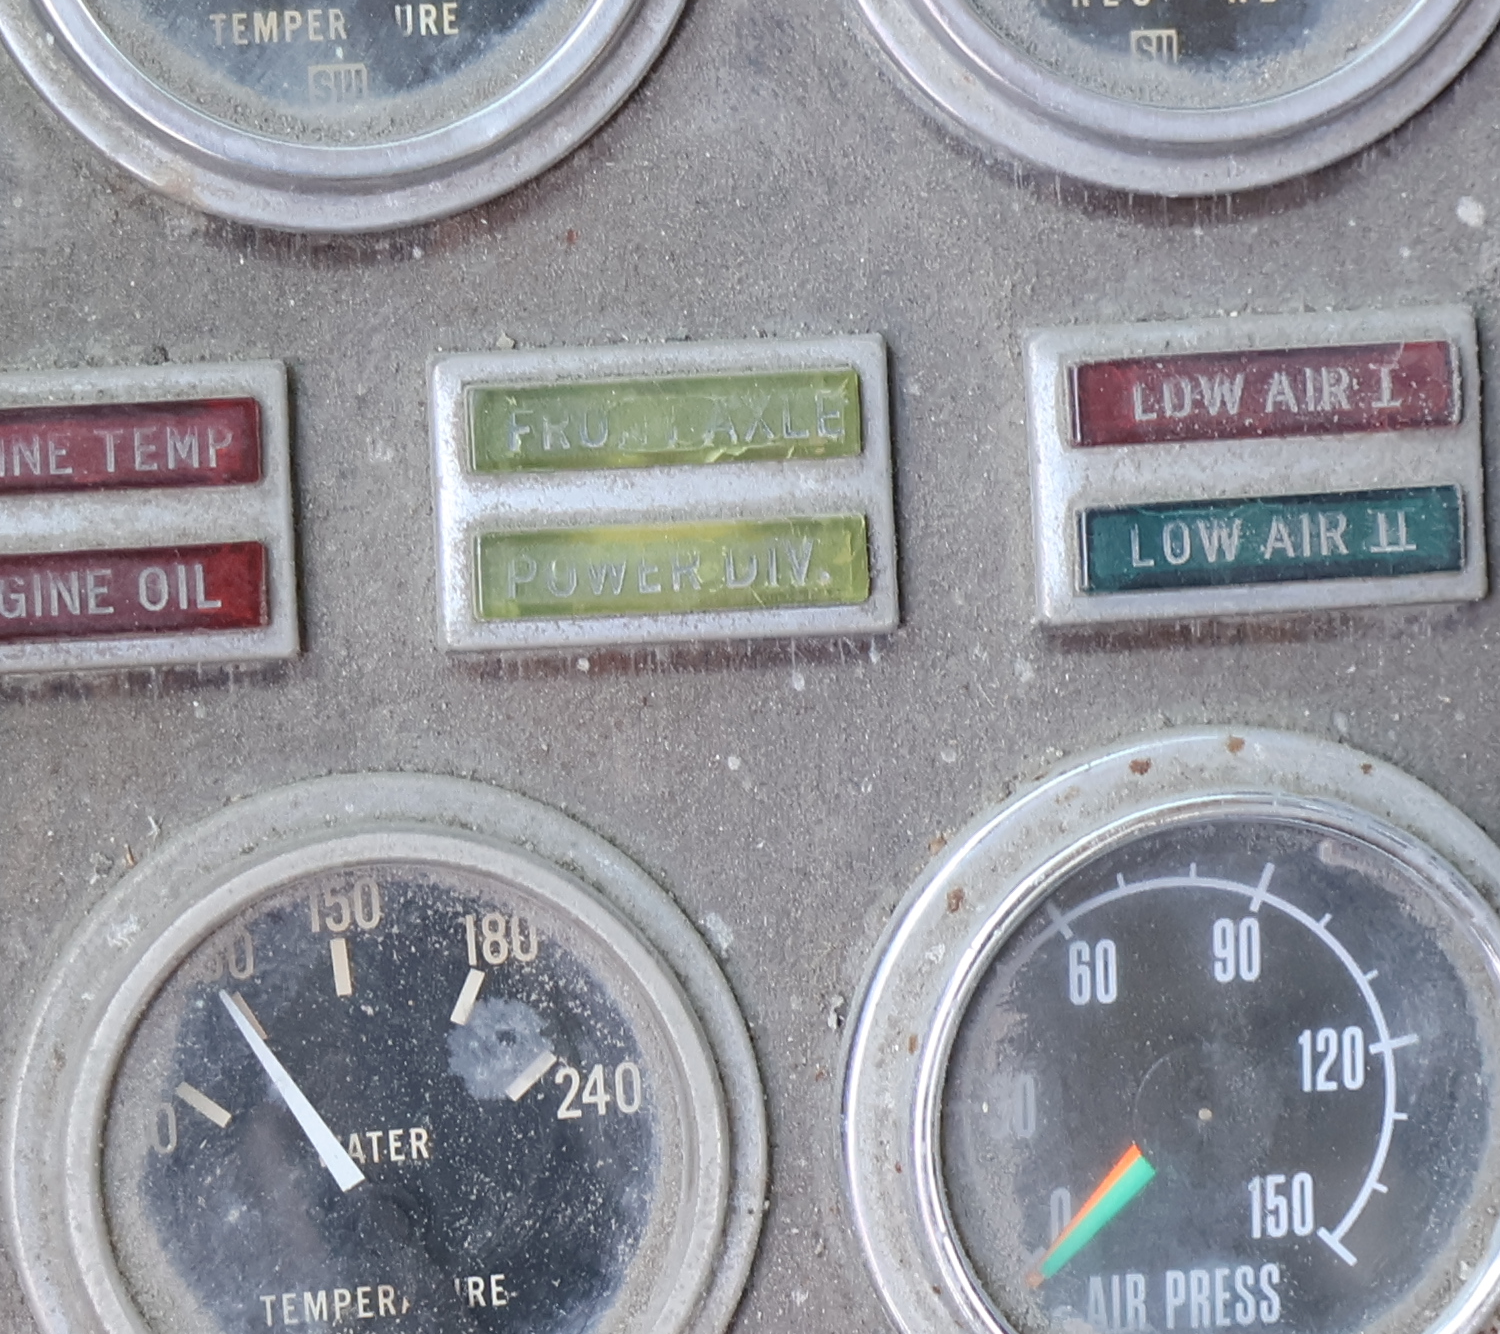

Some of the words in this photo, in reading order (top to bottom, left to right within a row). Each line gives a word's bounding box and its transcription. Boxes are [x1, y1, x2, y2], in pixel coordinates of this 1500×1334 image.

[208, 0, 460, 46] TEMPERURE
[702, 389, 846, 448] AXLE
[1132, 372, 1245, 421] LOW
[1264, 365, 1352, 414] AIR
[94, 424, 233, 474] TEMP
[507, 554, 700, 599] POWER
[724, 537, 831, 590] DIV.
[1130, 518, 1243, 568] LOW
[1263, 511, 1350, 561] AIR
[137, 562, 223, 612] OIL
[306, 878, 381, 933] 150
[463, 912, 539, 967] 180
[1212, 917, 1262, 982] 90
[1068, 938, 1118, 1006] 60
[1297, 1026, 1365, 1093] 120
[555, 1061, 643, 1120] 240
[318, 1127, 430, 1168] ATER
[1248, 1173, 1314, 1239] 150
[259, 1273, 509, 1327] TEMPERRE
[1086, 1272, 1148, 1332] AIR
[1165, 1264, 1281, 1329] PRESS
